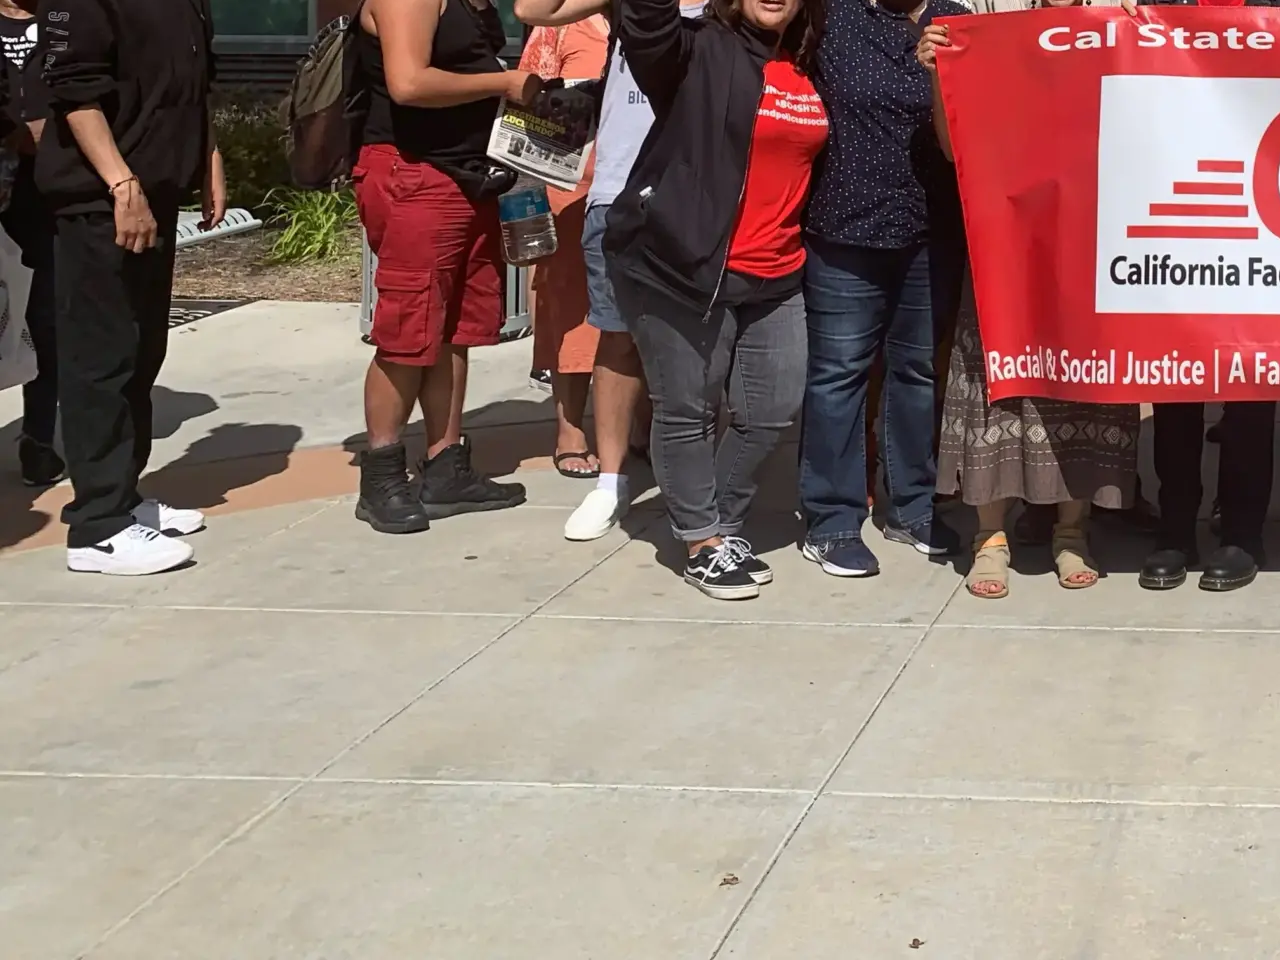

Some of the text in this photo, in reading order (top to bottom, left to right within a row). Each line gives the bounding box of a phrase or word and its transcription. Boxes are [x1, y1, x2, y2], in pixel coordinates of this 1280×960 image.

[1038, 23, 1116, 52] Cal
[1138, 24, 1276, 51] State
[1110, 254, 1240, 287] California
[988, 346, 1044, 380] Racial
[1045, 348, 1057, 381] &
[1060, 349, 1115, 385] Social
[1122, 349, 1205, 386] Justice
[1228, 351, 1246, 384] A
